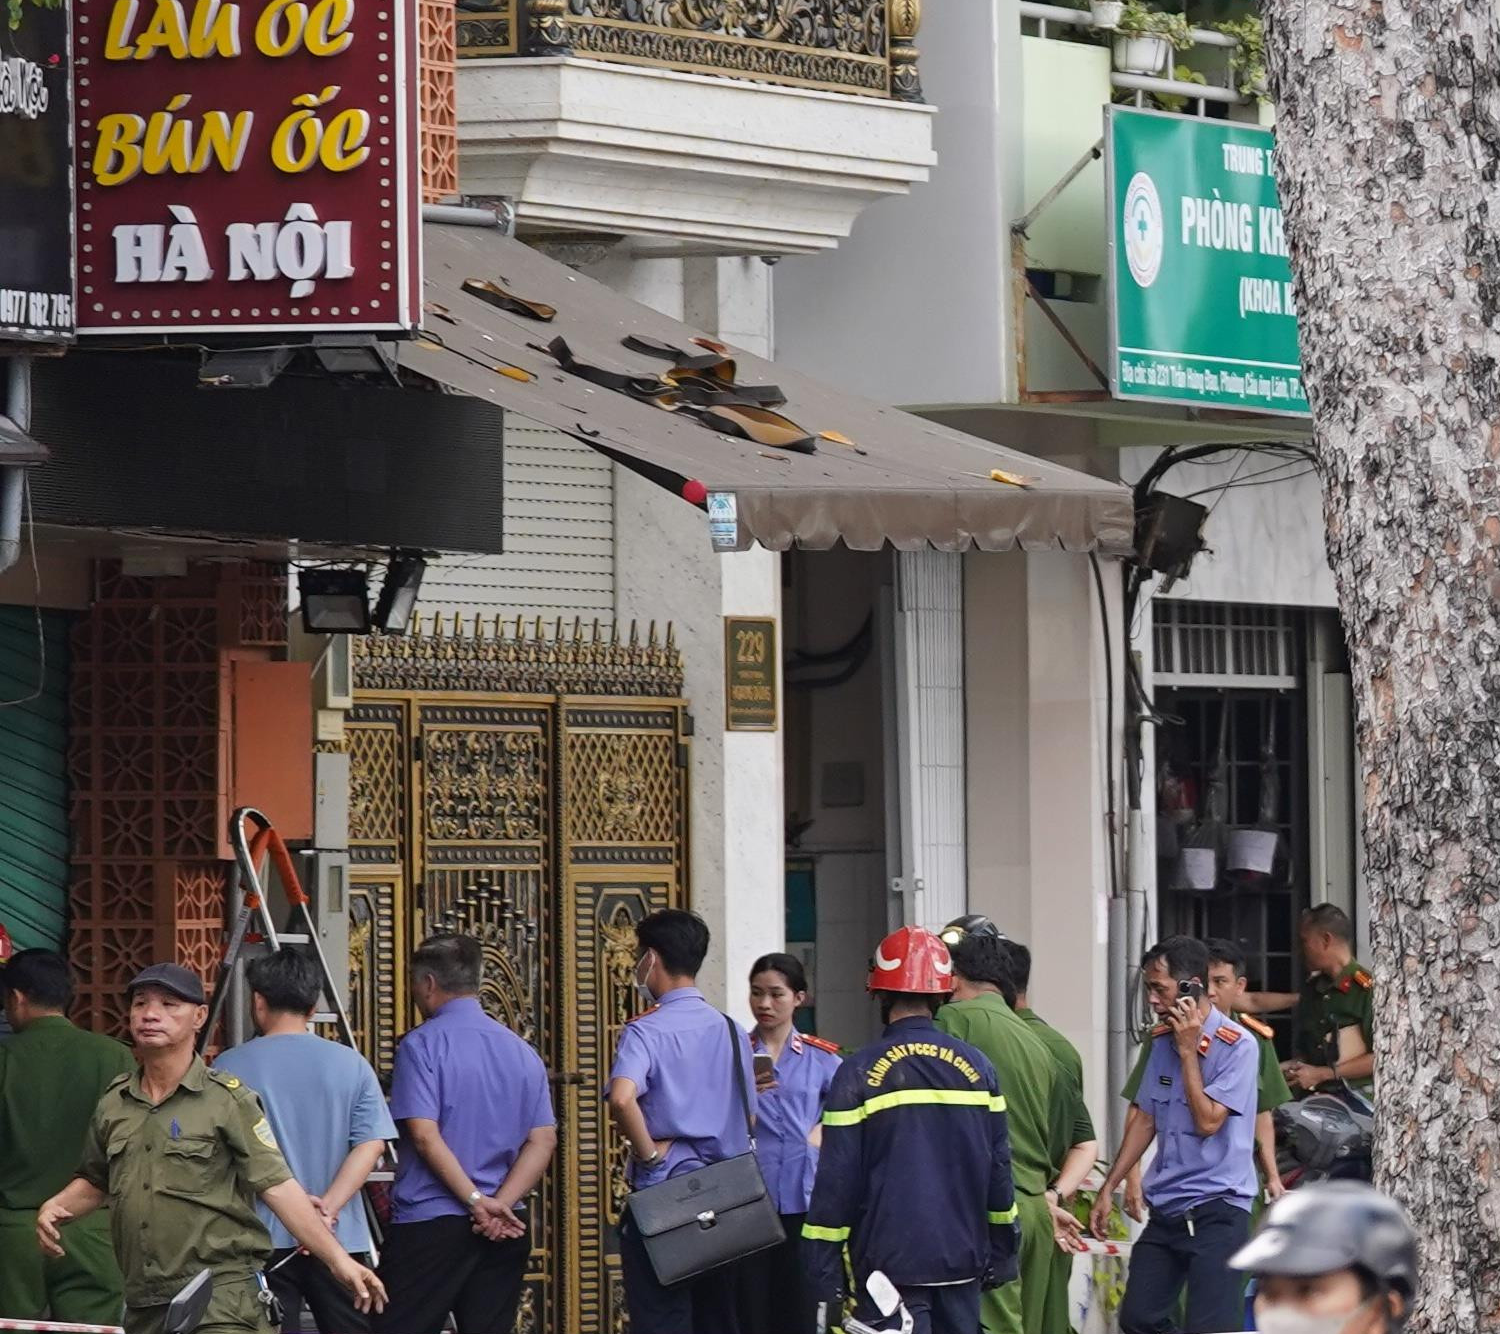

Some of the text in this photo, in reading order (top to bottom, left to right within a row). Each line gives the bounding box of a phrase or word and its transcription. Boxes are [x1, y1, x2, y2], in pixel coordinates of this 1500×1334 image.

[92, 85, 371, 186] BÚN ỐC
[1221, 142, 1263, 175] TRUNG
[1181, 188, 1253, 253] PHÒNG
[112, 202, 355, 299] HÀ NỘI
[1238, 276, 1281, 319] (KHOA
[735, 629, 765, 664] 229
[867, 1042, 981, 1088] CẢNH SÁT PCCC VÀ CNCH
